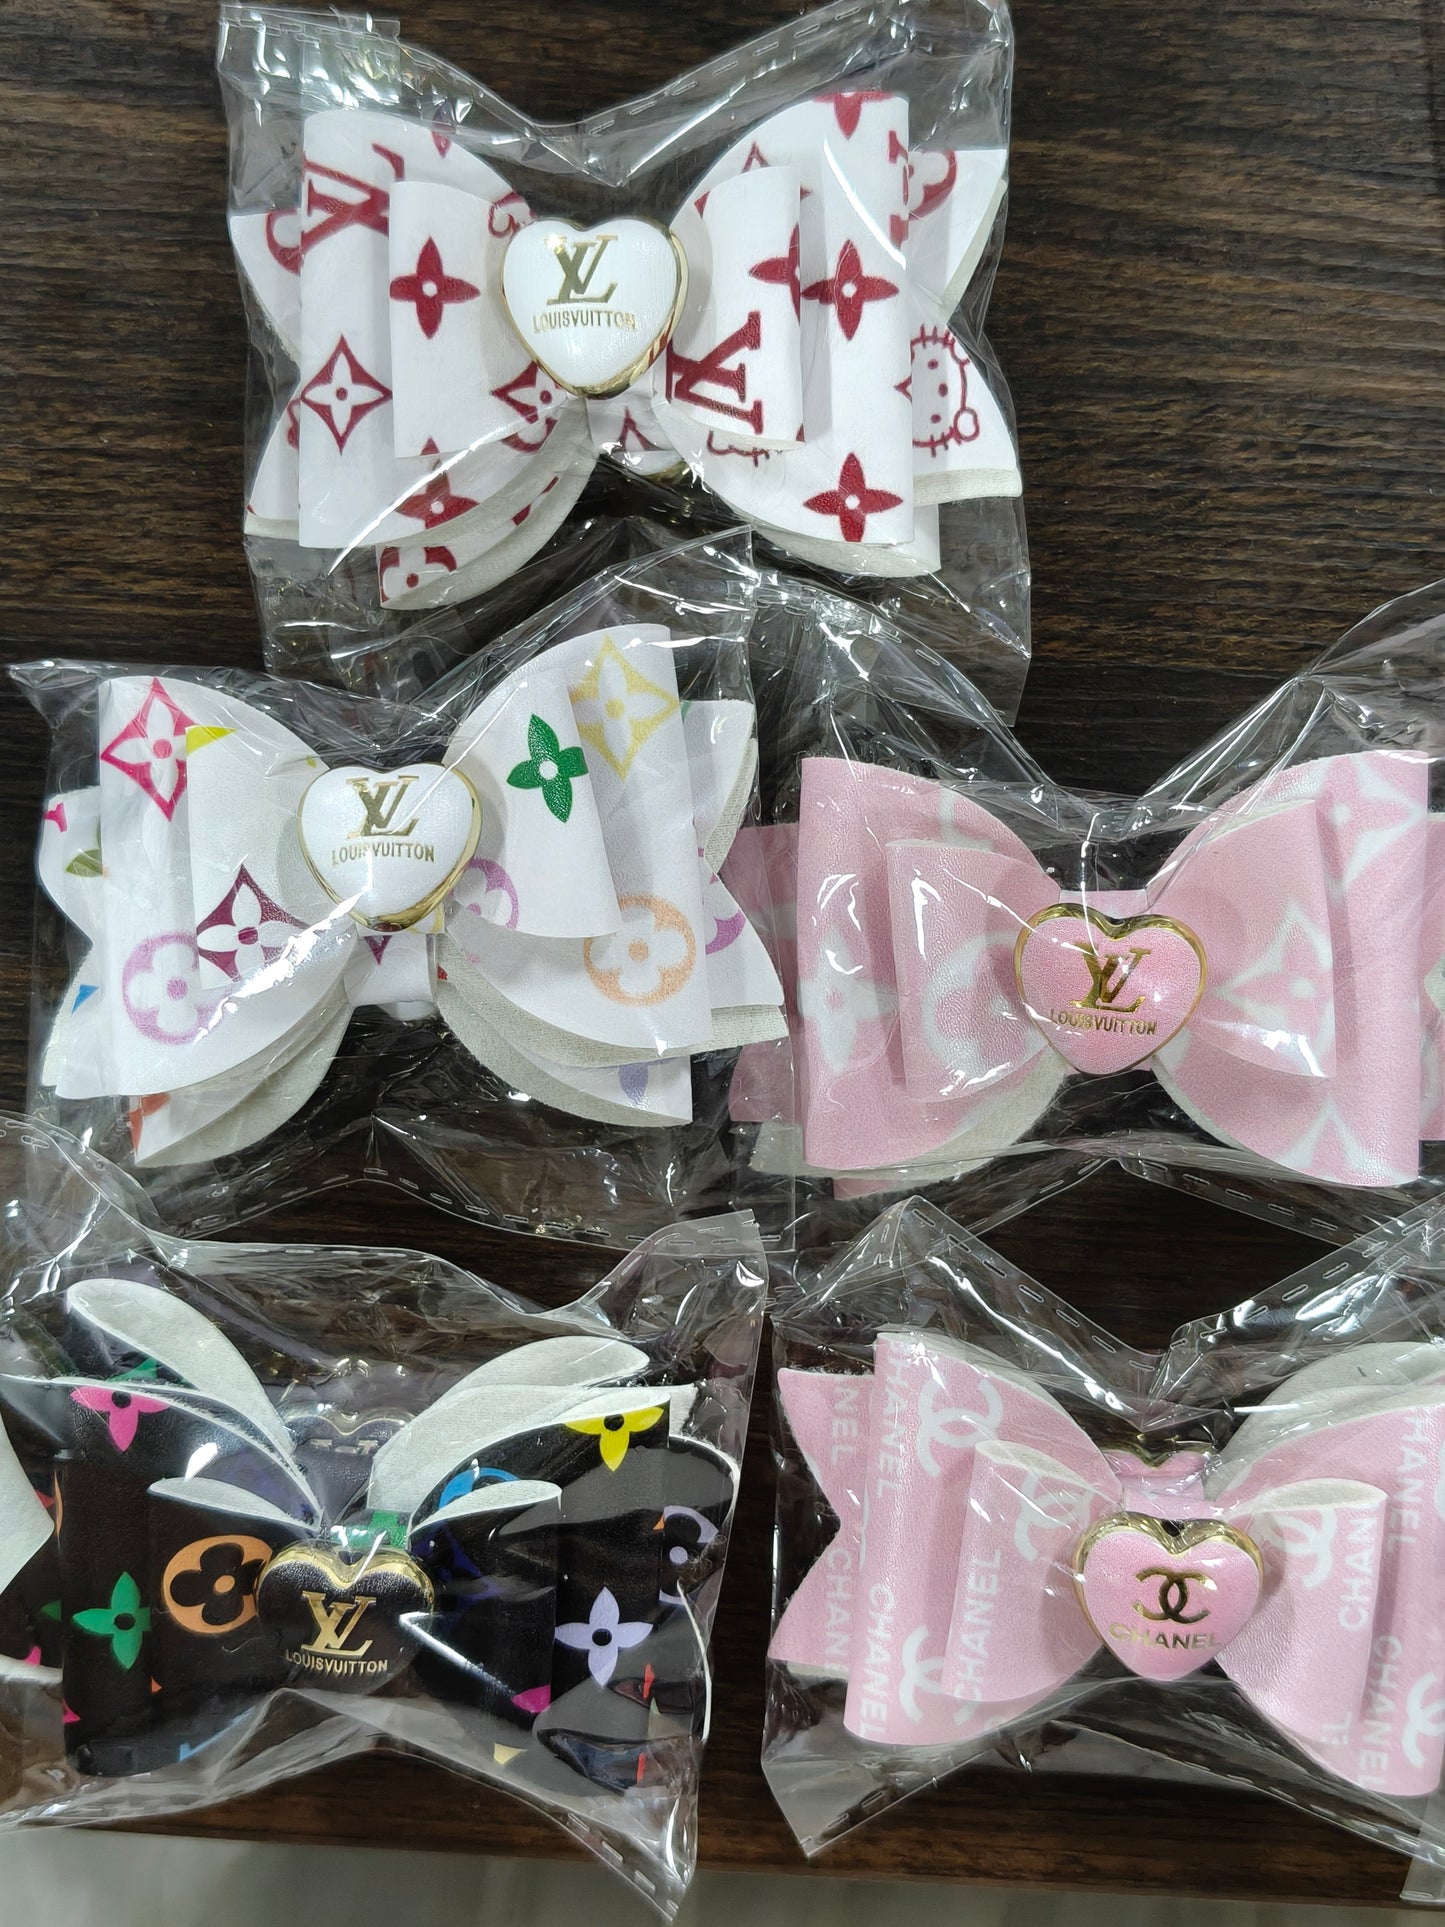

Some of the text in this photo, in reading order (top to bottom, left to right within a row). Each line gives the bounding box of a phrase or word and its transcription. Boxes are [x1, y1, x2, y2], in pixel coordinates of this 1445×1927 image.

[1050, 1009, 1157, 1036] LOUISVUITTON
[301, 1590, 377, 1659] LV
[1108, 1622, 1222, 1650] CHANEL
[285, 1649, 388, 1674] LOUISVUITTON
